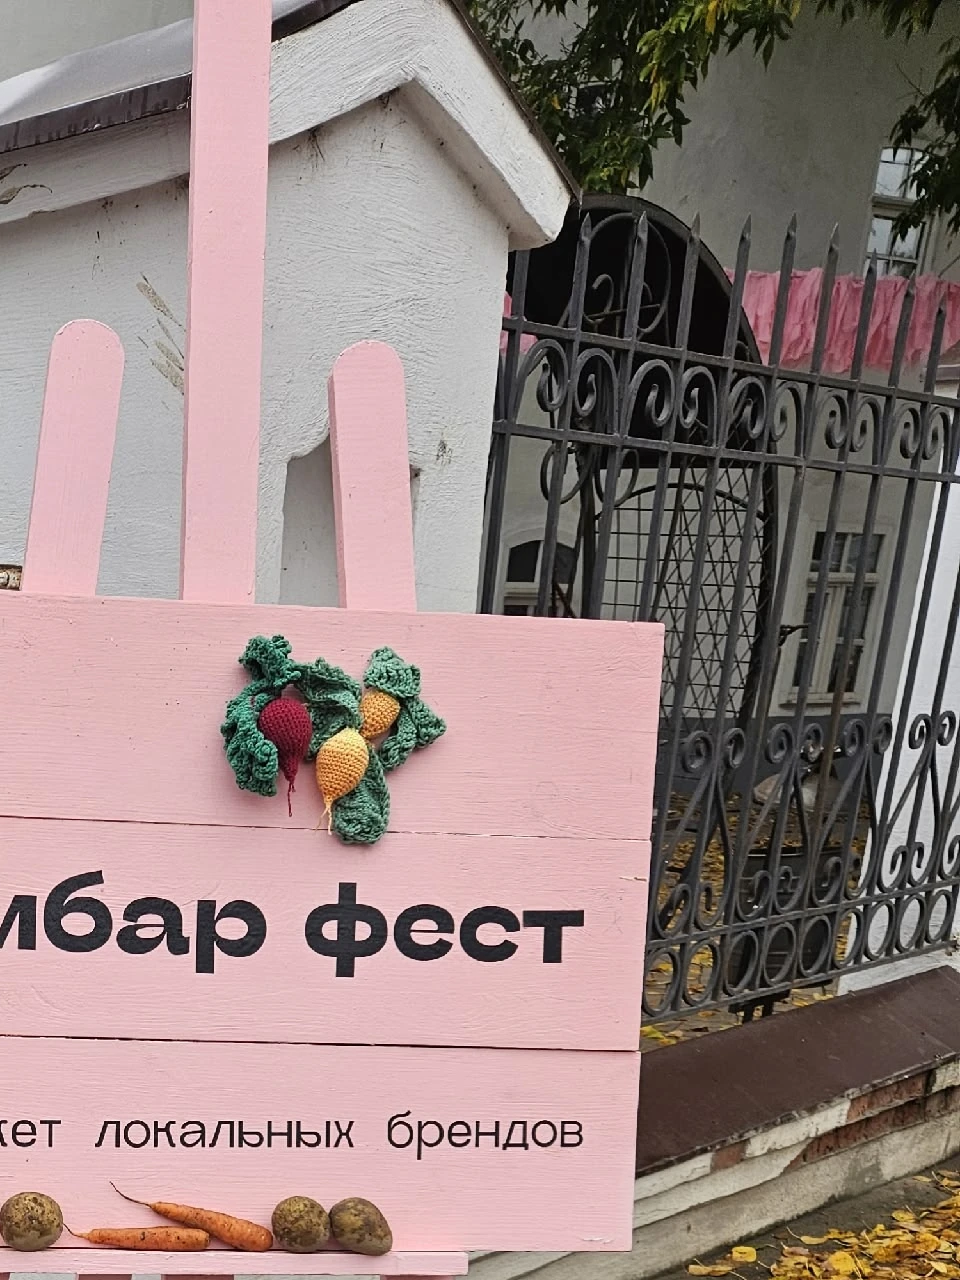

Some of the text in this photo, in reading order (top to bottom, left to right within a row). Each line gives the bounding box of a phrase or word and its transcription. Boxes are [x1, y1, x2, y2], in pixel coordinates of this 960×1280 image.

[305, 883, 585, 978] фест
[95, 1119, 355, 1149] локальных
[387, 1110, 584, 1160] брендов
